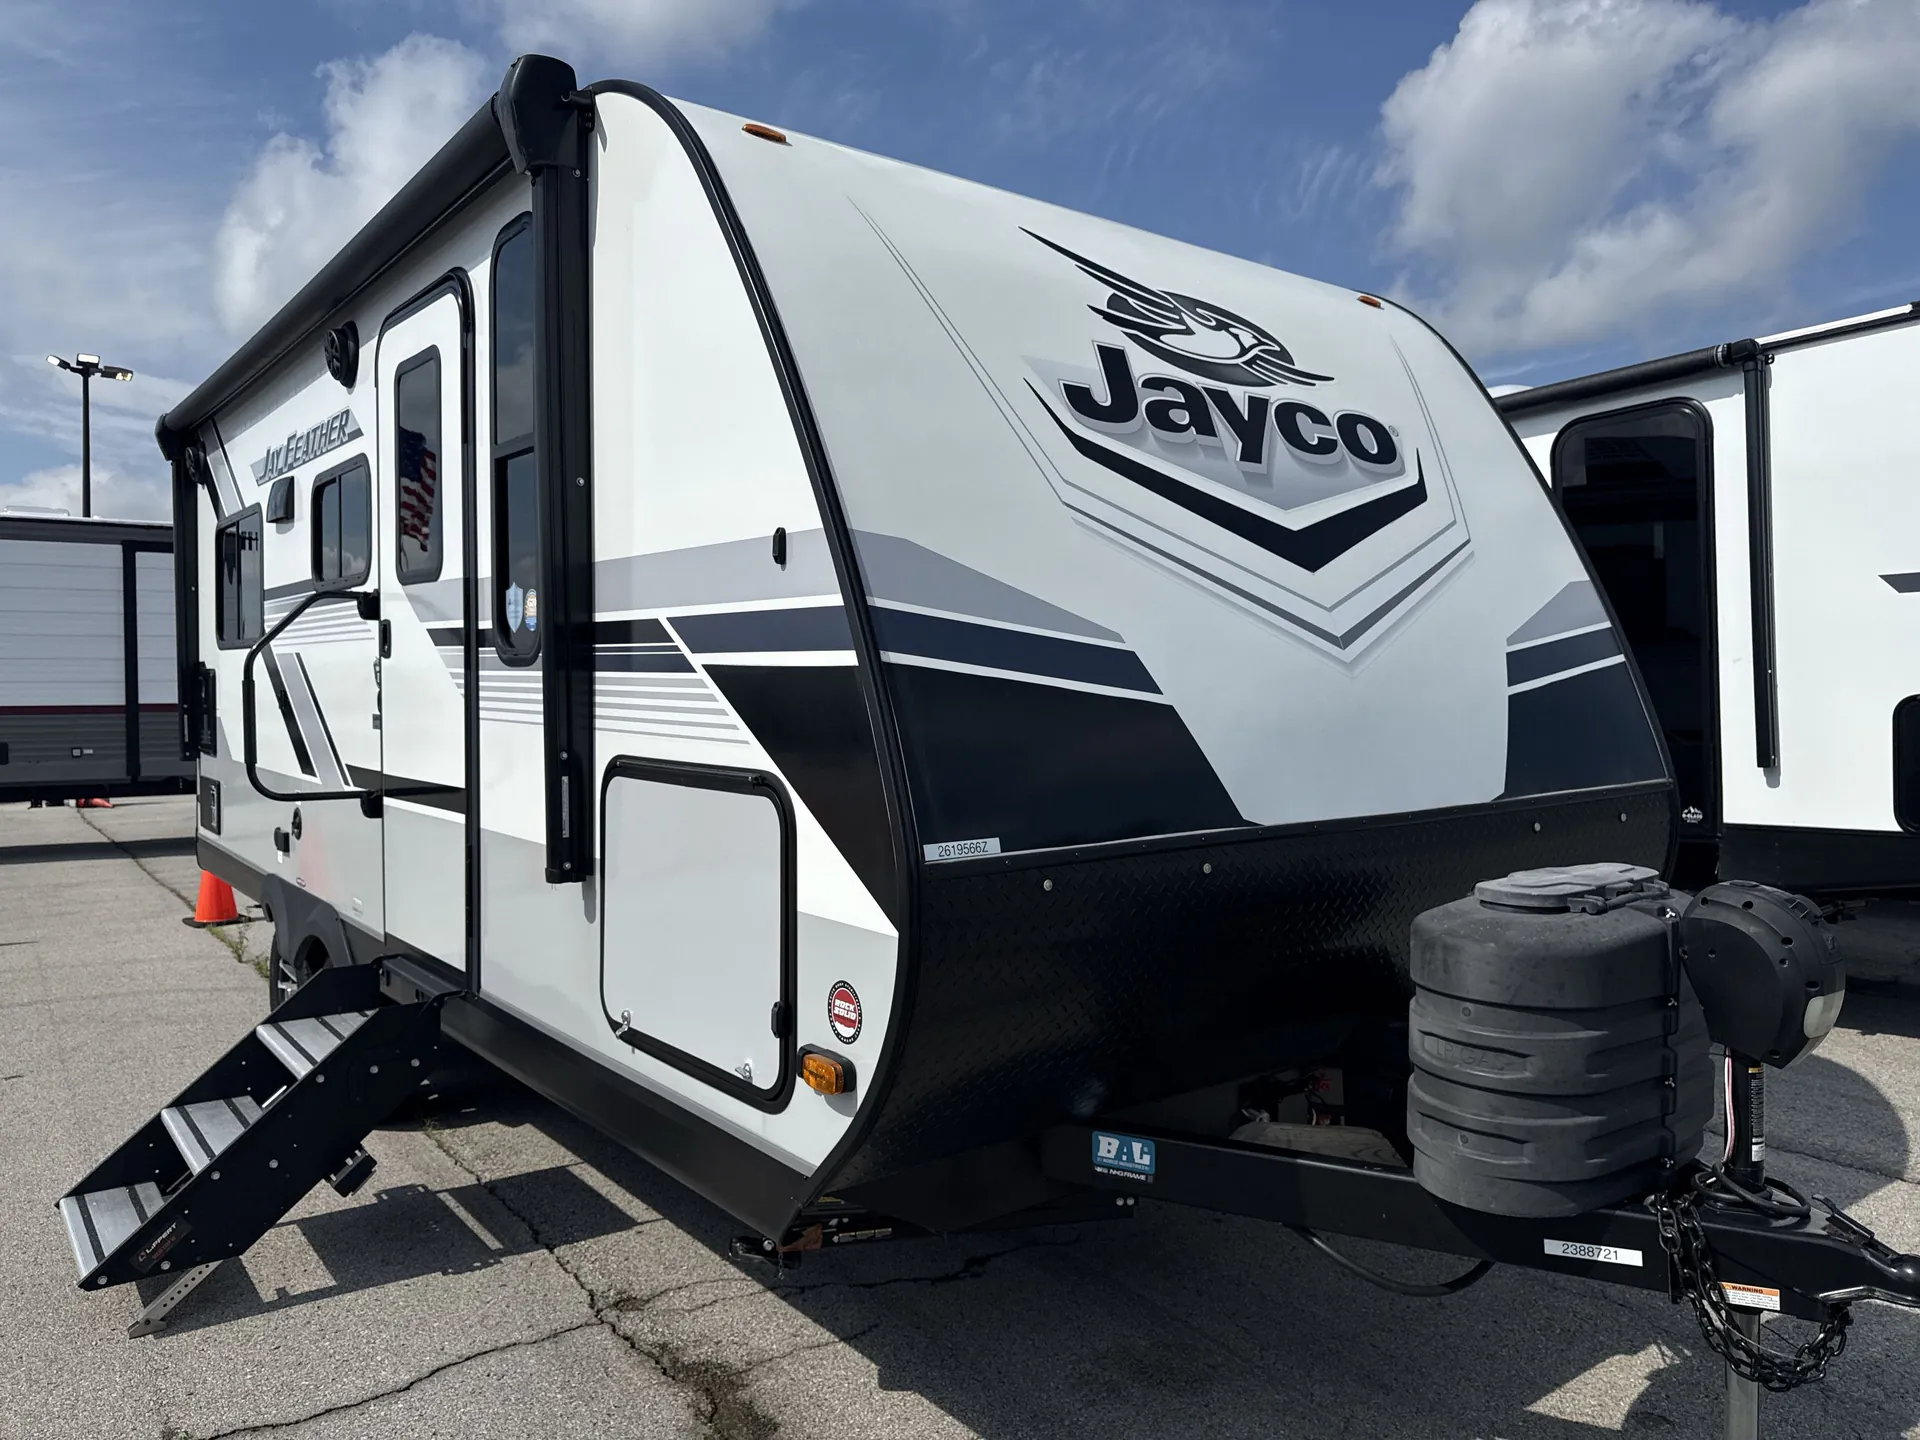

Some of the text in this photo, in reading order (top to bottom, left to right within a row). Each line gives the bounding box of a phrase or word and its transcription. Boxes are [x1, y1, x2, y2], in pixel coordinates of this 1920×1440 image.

[1060, 341, 1399, 470] Jayco
[257, 407, 350, 481] JAY FEATHER
[938, 841, 988, 857] 2619566Z
[834, 998, 855, 1012] ROCK
[833, 1006, 857, 1021] SOLID
[1124, 1171, 1147, 1181] FRAME
[145, 1222, 177, 1254] LIPPERT
[1562, 1243, 1618, 1261] 2388721
[1731, 1285, 1764, 1294] WARNING
